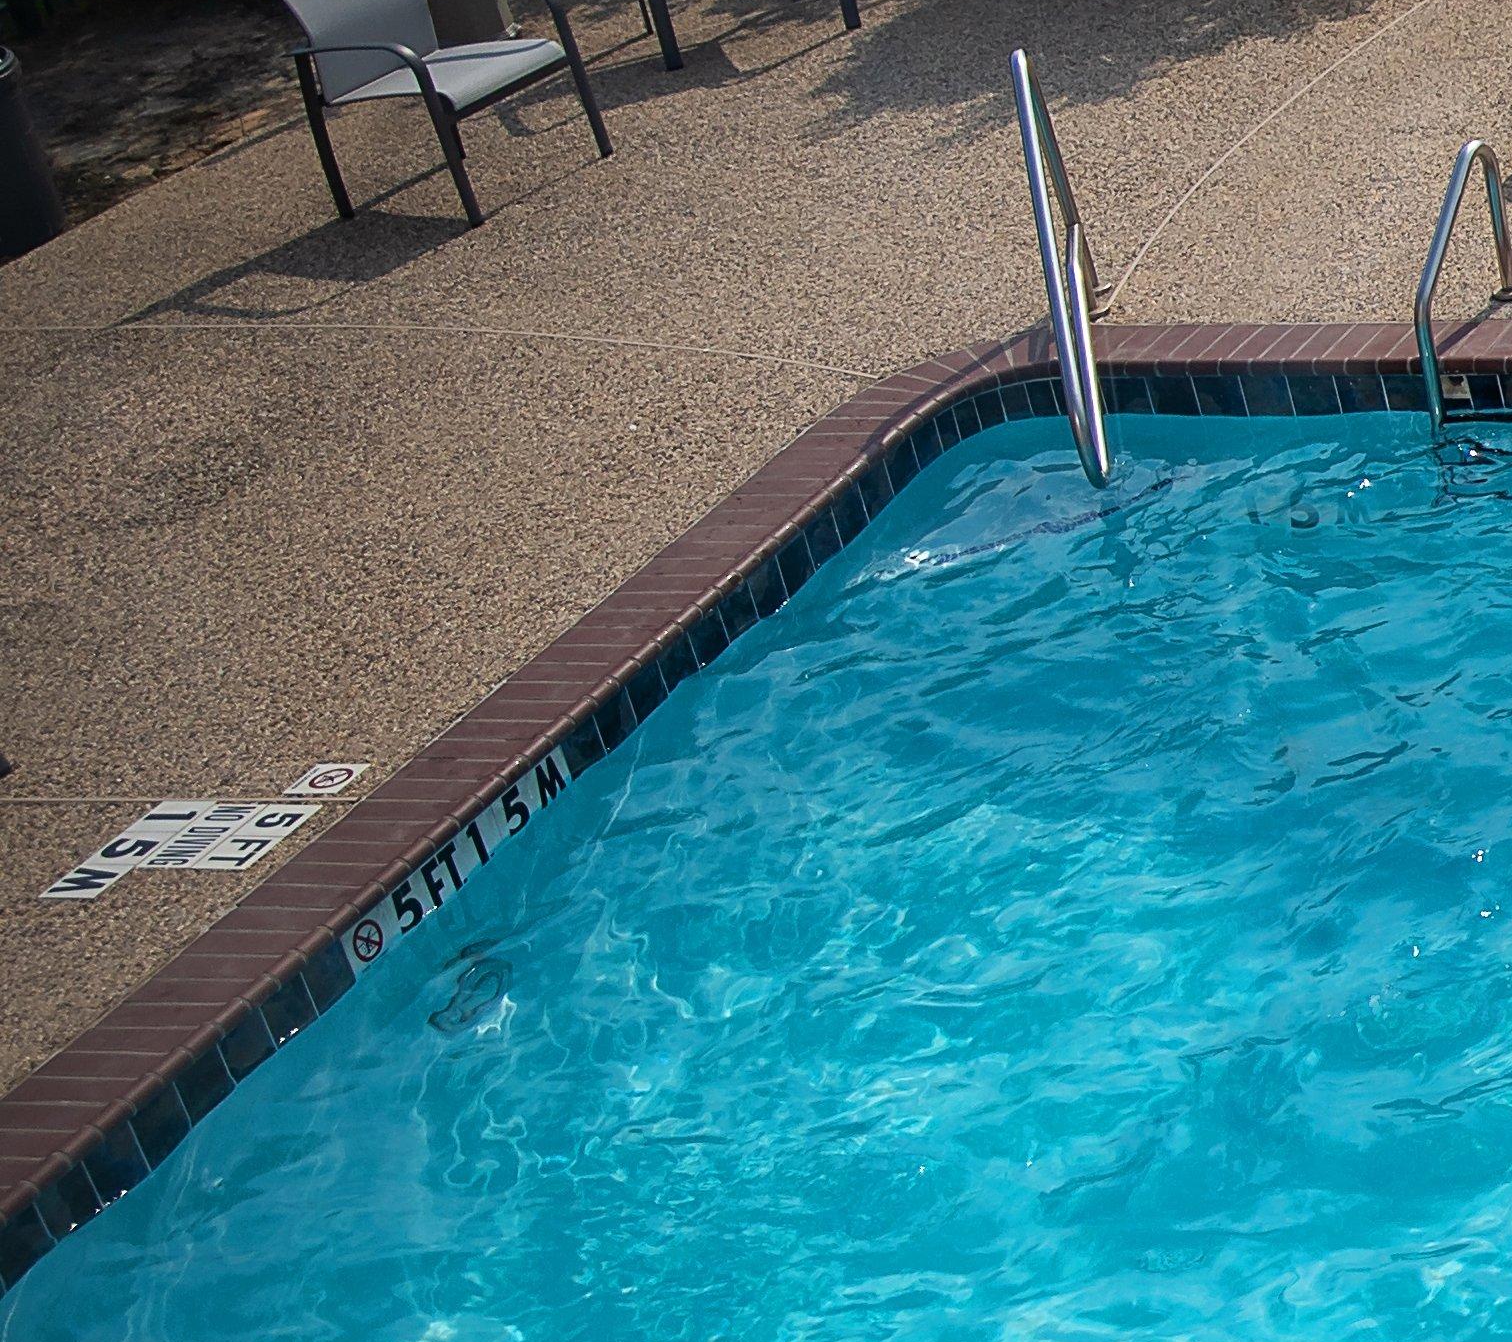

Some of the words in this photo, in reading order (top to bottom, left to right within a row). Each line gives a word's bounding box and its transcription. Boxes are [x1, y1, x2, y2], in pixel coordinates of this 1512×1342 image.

[204, 806, 257, 821] NO
[254, 812, 304, 828] 5
[101, 837, 159, 859] 5
[149, 826, 230, 866] DIVING
[208, 838, 270, 867] FT
[391, 880, 424, 934] 5
[535, 755, 567, 809] M
[48, 867, 119, 893] M
